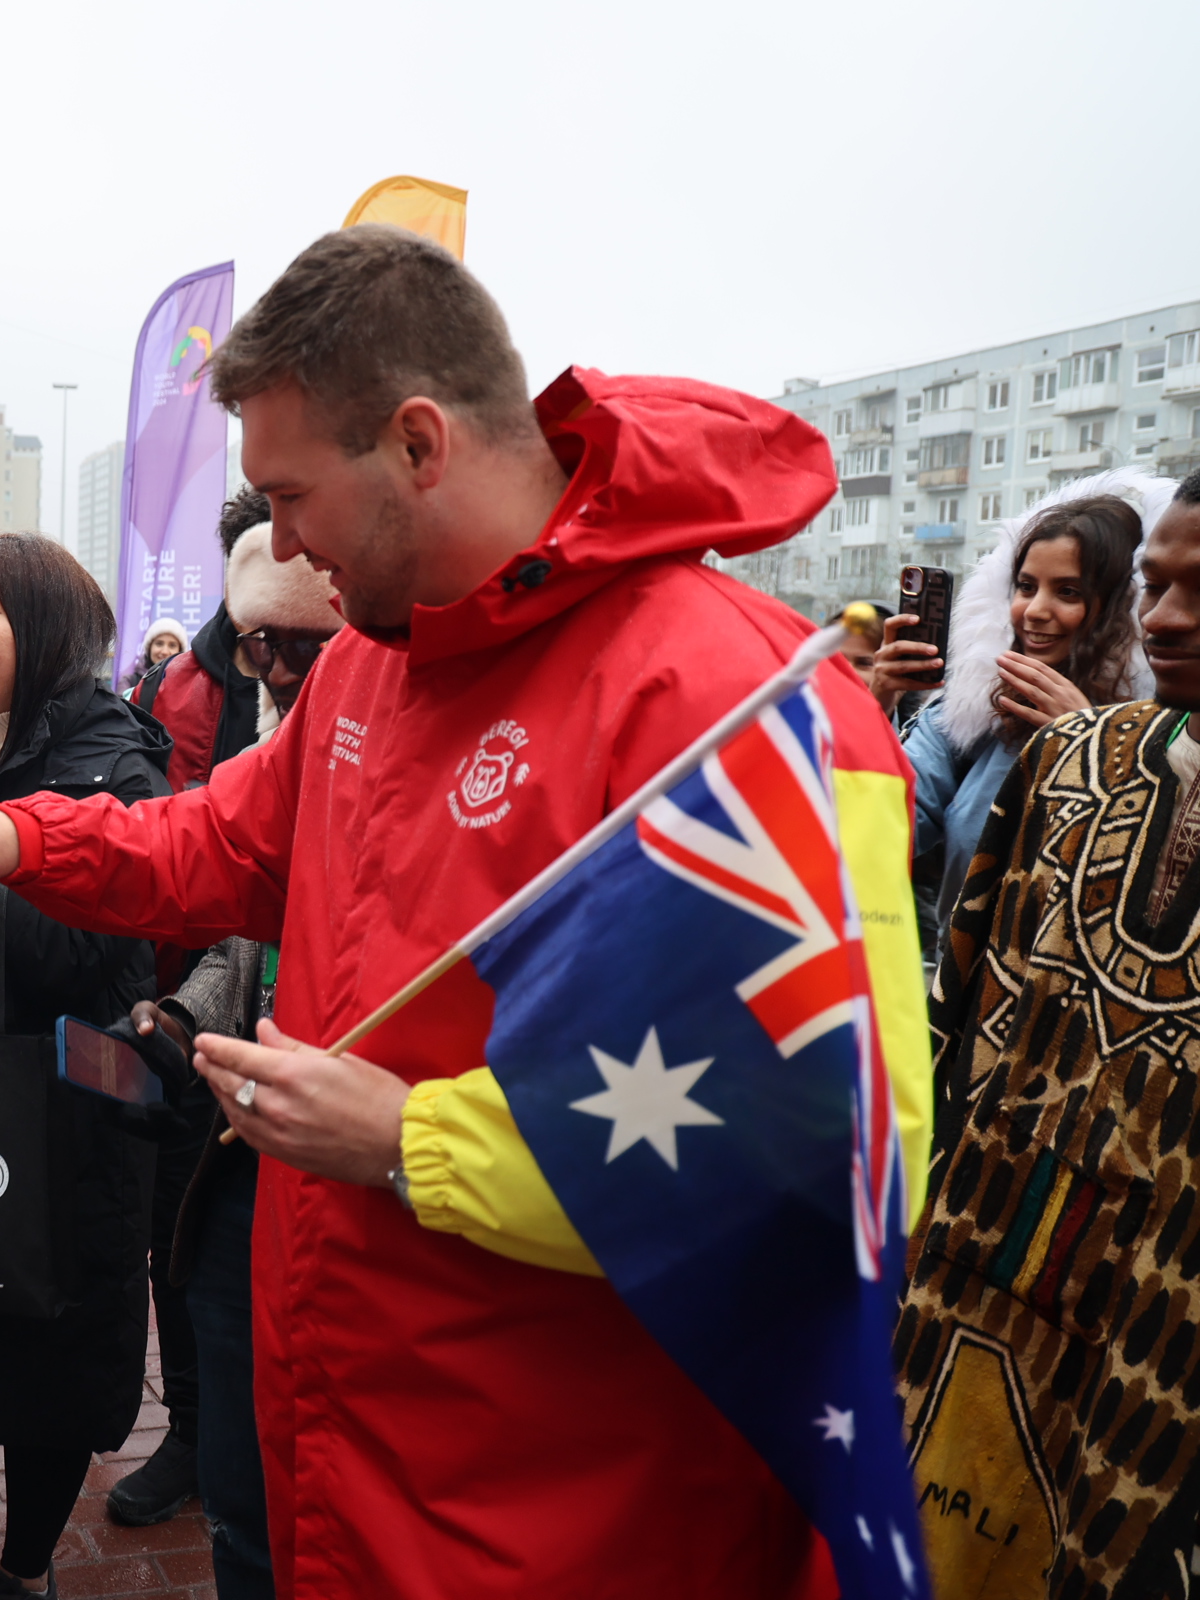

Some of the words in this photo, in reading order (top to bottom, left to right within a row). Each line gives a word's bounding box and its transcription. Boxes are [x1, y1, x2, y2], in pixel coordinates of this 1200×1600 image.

[139, 551, 158, 631] START
[156, 549, 175, 618] TURE
[916, 1481, 1019, 1546] MALI
